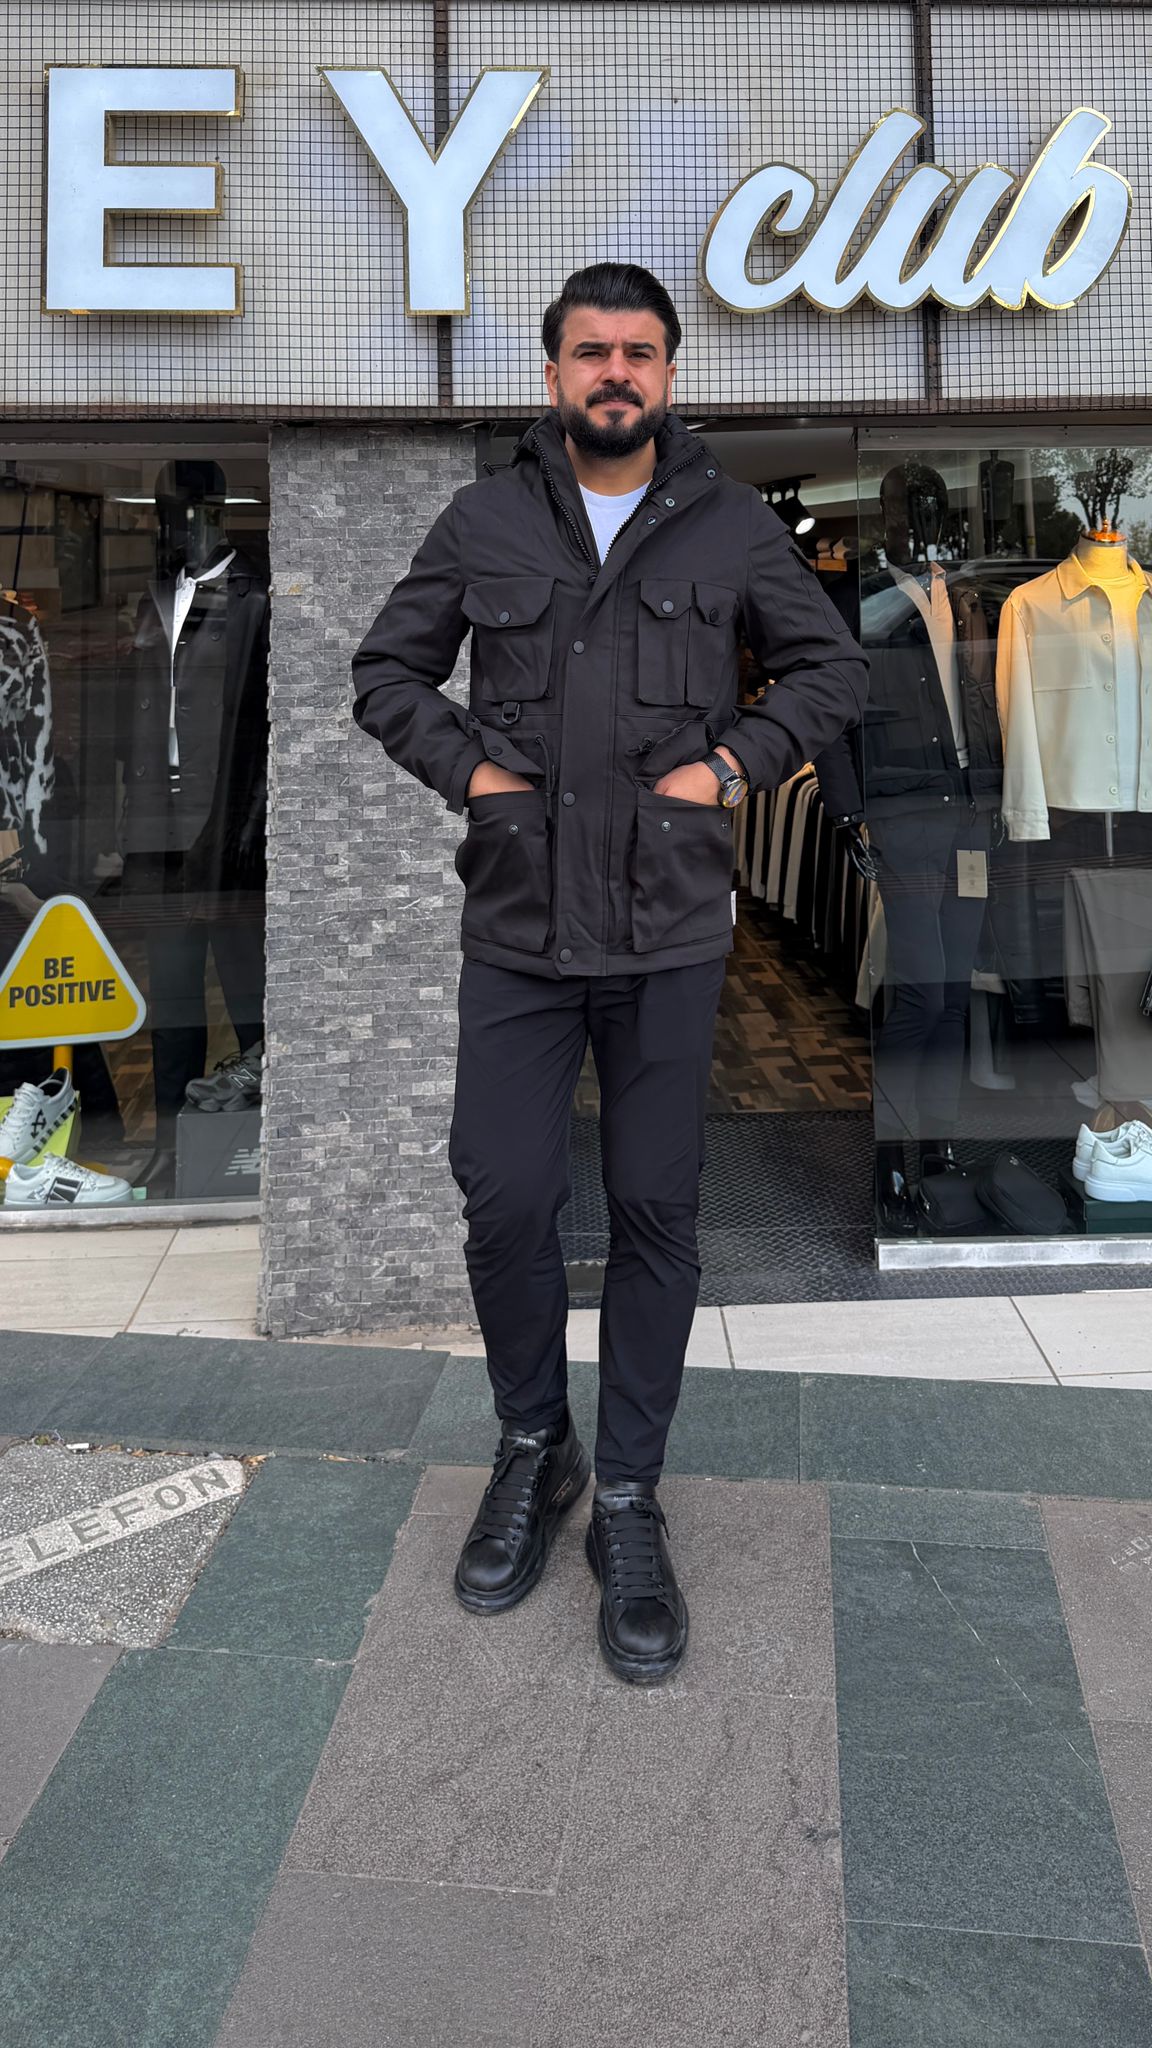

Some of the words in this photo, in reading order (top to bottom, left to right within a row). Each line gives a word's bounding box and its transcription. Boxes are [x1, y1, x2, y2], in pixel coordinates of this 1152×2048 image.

[697, 106, 1133, 313] club
[44, 956, 75, 979] BE
[9, 979, 116, 1008] POSITIVE
